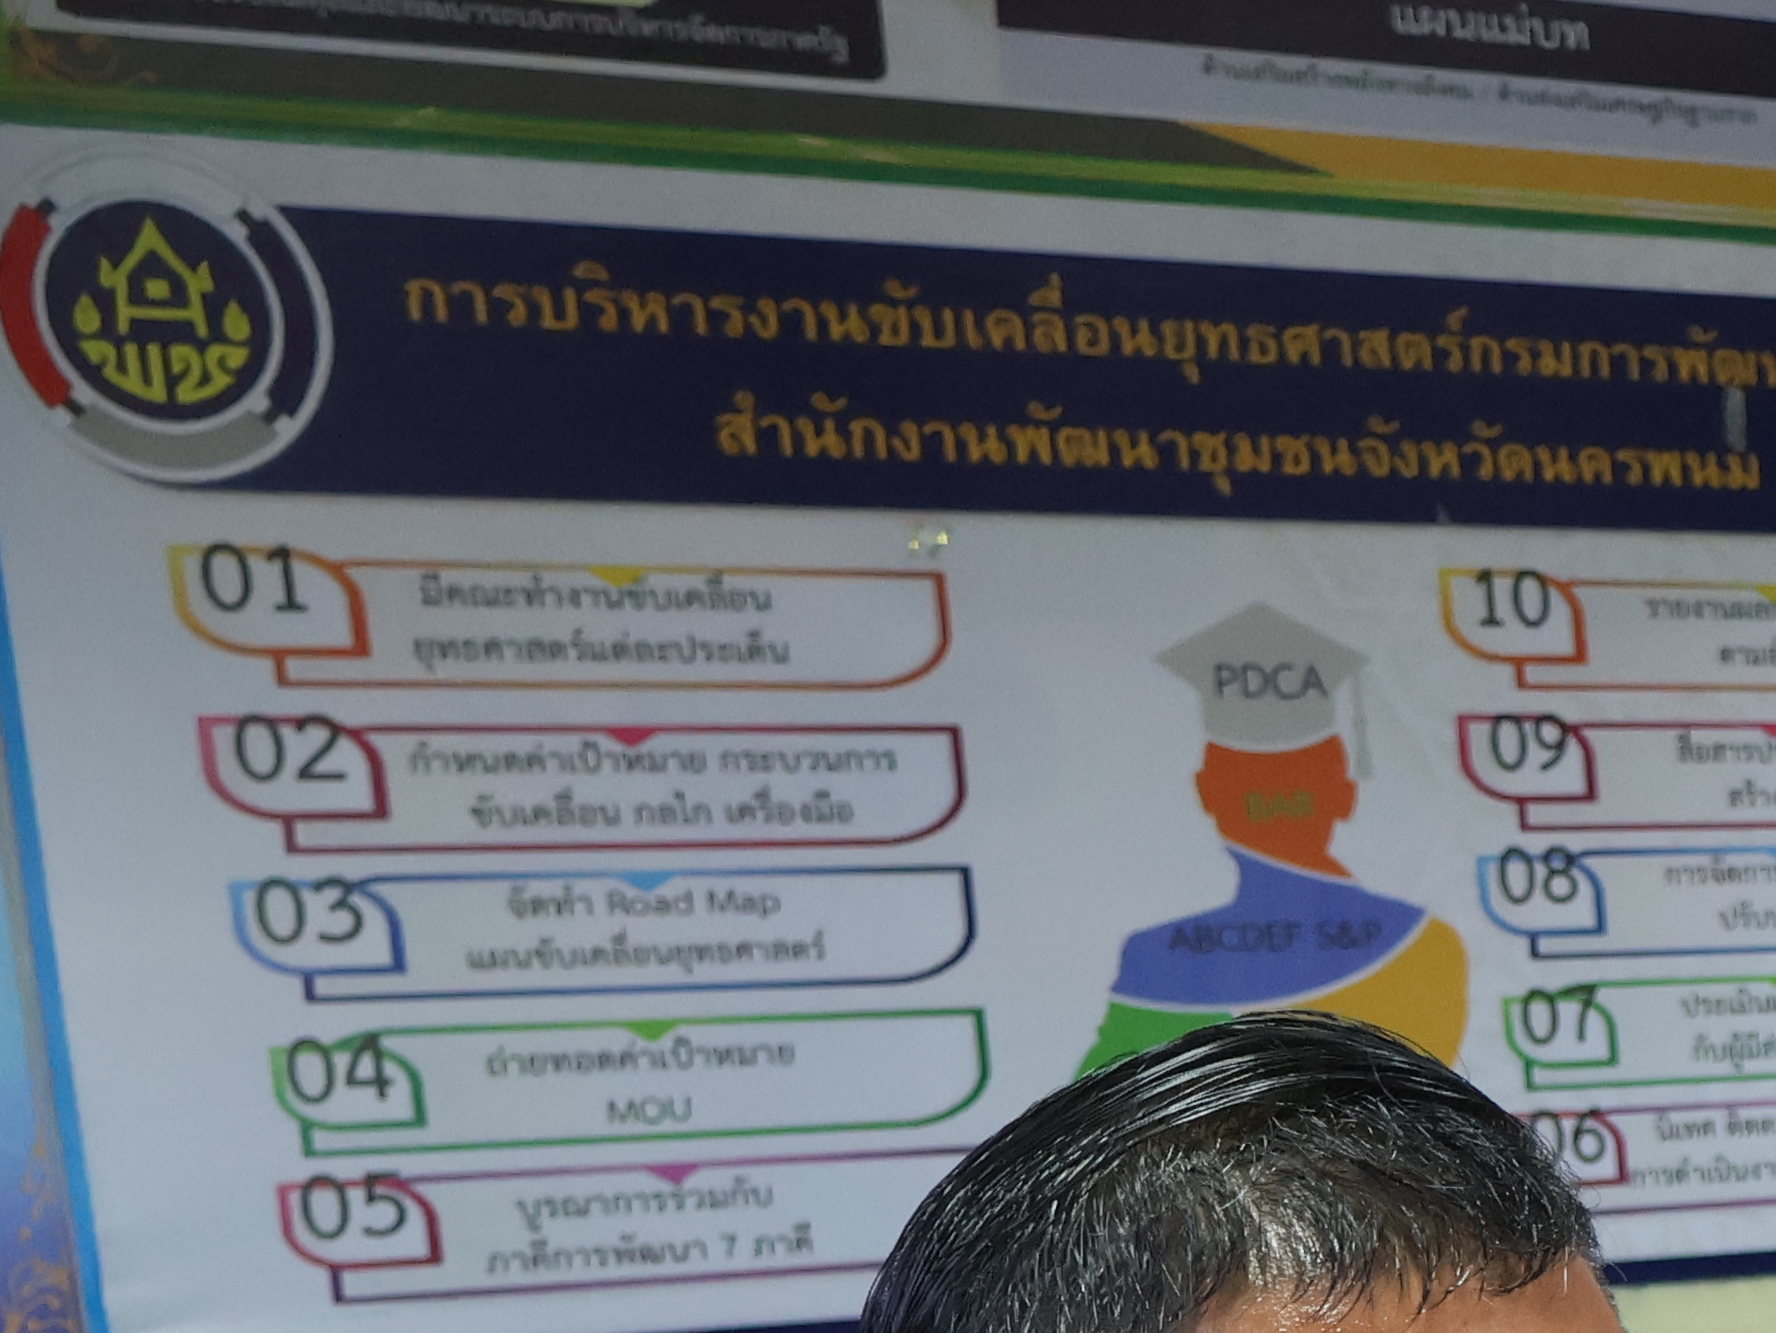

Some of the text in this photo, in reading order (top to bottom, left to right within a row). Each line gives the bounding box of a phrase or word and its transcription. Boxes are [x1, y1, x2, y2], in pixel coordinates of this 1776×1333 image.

[1391, 4, 1592, 50] แผนแม่บท
[714, 392, 1762, 497] สำนักงานพัฒนาชุมชนจังหวัดนครพนม
[200, 542, 309, 614] 01
[1474, 569, 1553, 629] 10
[1213, 661, 1329, 701] PDCA
[234, 713, 347, 783] 02
[720, 746, 899, 774] กระบวนการ
[1490, 713, 1569, 772] 09
[469, 785, 854, 830] ขับเคลื่อน กลไก เครื่องมือ
[507, 885, 781, 919] จัดทำ Road Map
[1498, 846, 1578, 905] 08
[254, 875, 365, 945] 03
[1168, 919, 1382, 956] ABCDEF S&P
[1522, 984, 1602, 1045] 07
[286, 1033, 393, 1104] 04
[606, 1097, 693, 1125] MOU
[1533, 1110, 1604, 1165] 06
[300, 1172, 409, 1241] 05
[720, 1234, 740, 1259] 7
